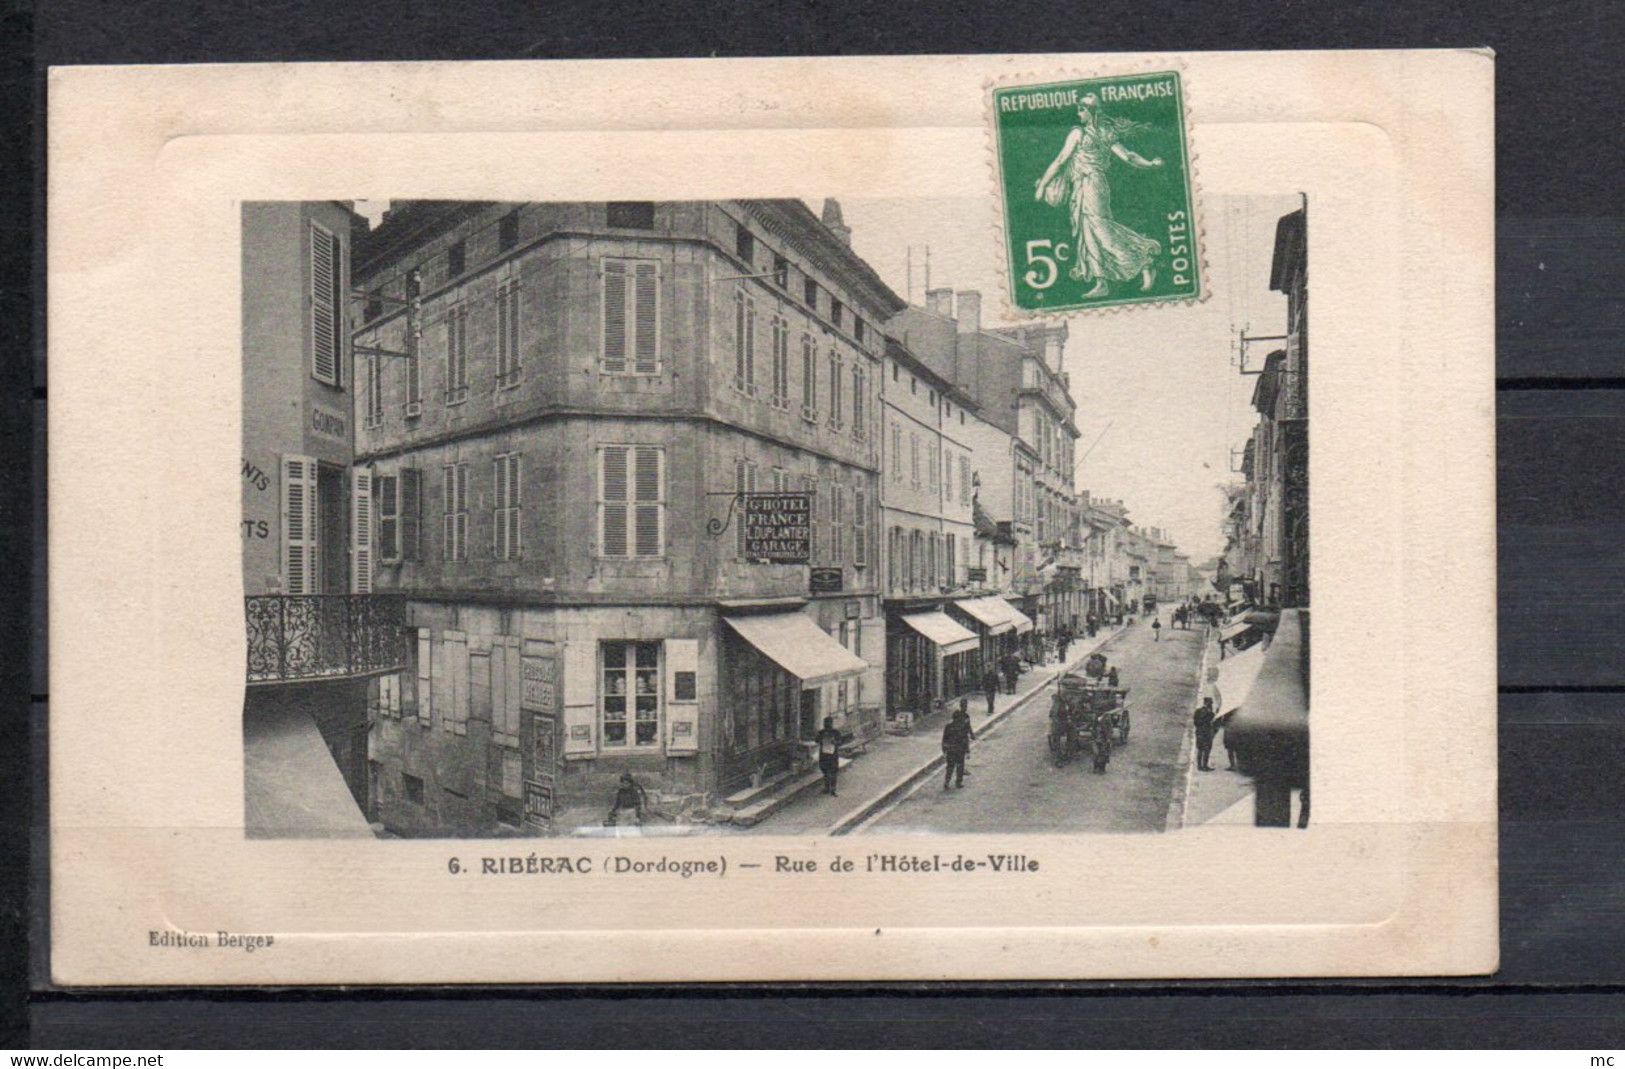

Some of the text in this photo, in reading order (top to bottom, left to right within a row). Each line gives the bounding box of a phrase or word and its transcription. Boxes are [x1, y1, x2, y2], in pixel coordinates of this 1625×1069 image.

[1001, 80, 1174, 113] REPUBLIQUE FRANÇAISE
[1168, 210, 1190, 286] POSTES
[748, 513, 808, 525] FRANCE
[751, 540, 805, 551] GARAGE
[481, 853, 592, 874] RIBÉRAC
[603, 855, 727, 878] (Dordogne)
[775, 856, 817, 872] Rue
[829, 856, 854, 872] de
